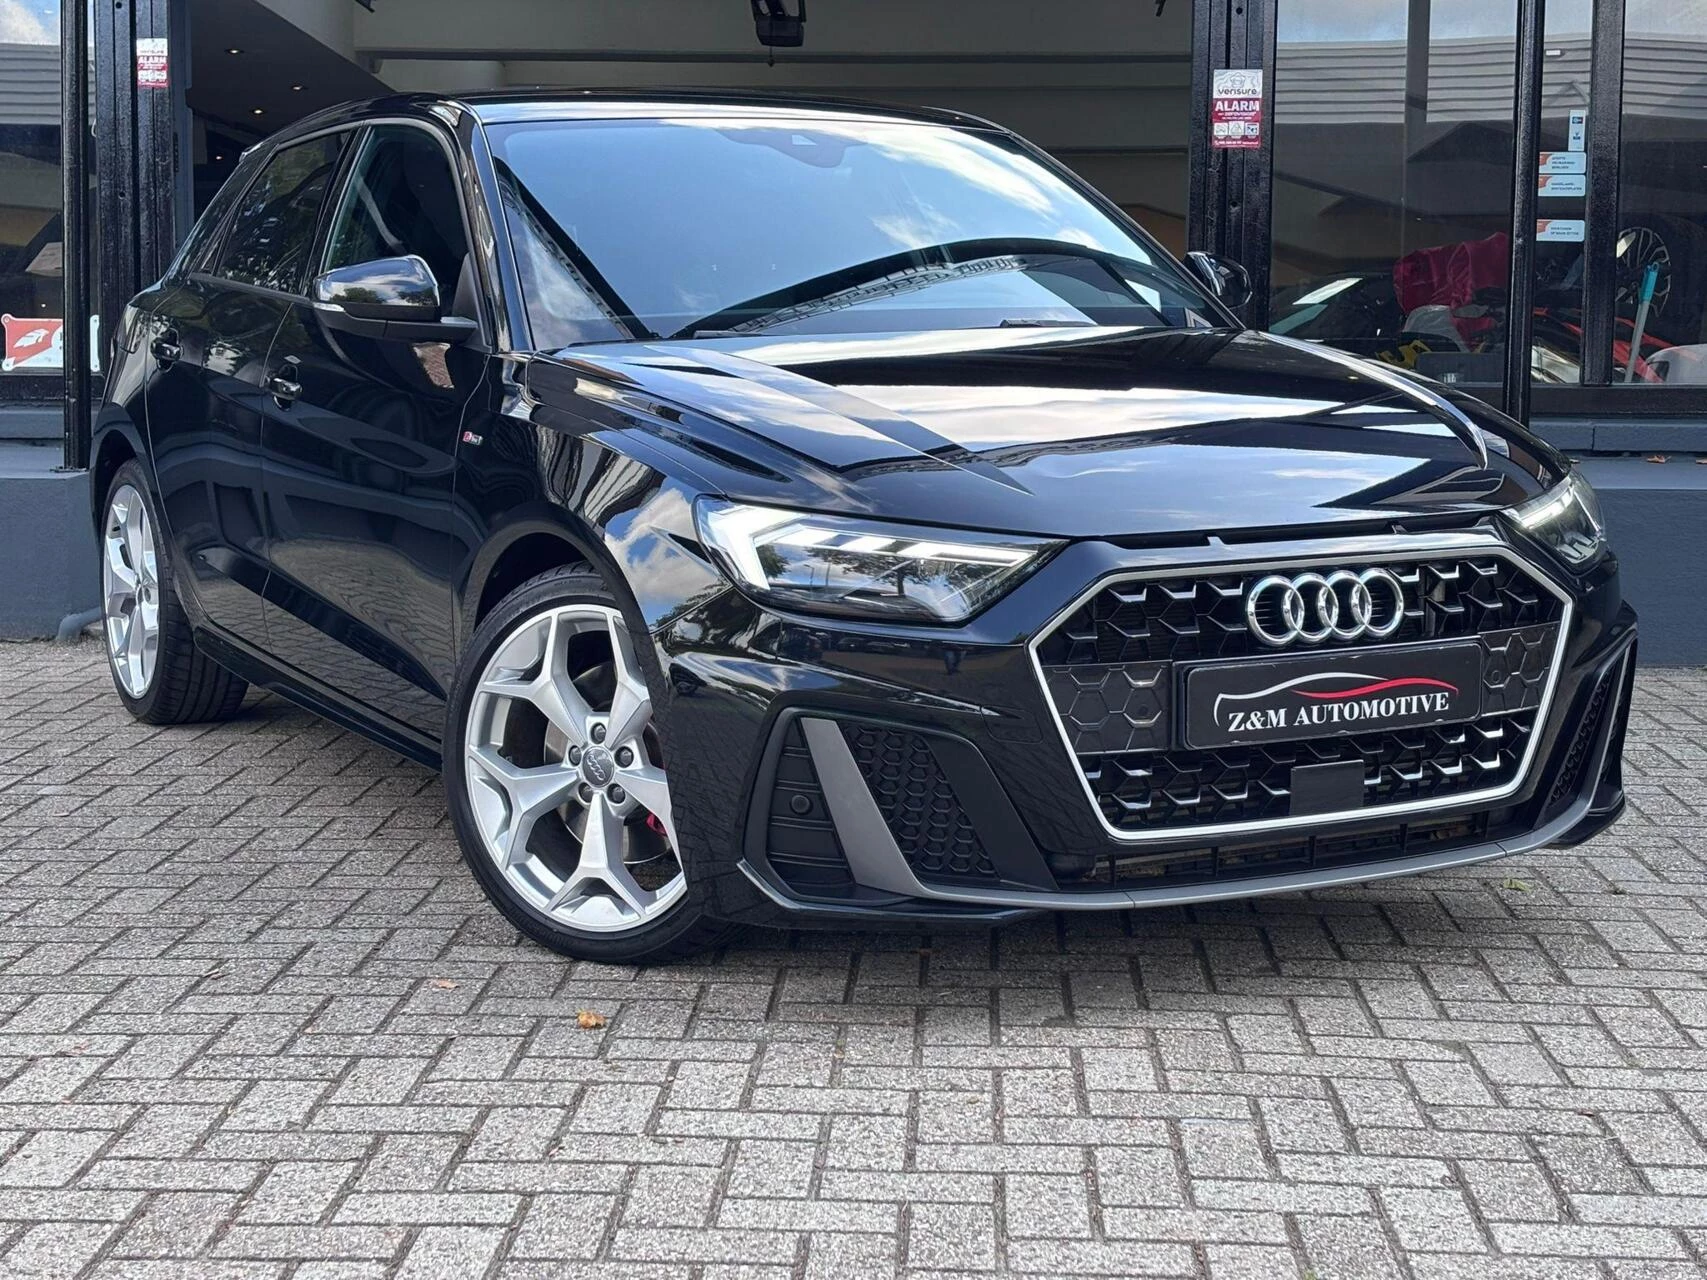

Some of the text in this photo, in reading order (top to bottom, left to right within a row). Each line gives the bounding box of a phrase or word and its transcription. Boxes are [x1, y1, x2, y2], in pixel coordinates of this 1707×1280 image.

[1215, 100, 1260, 111] ALARM
[1228, 692, 1449, 732] Z&M AUTOMOTIVE
